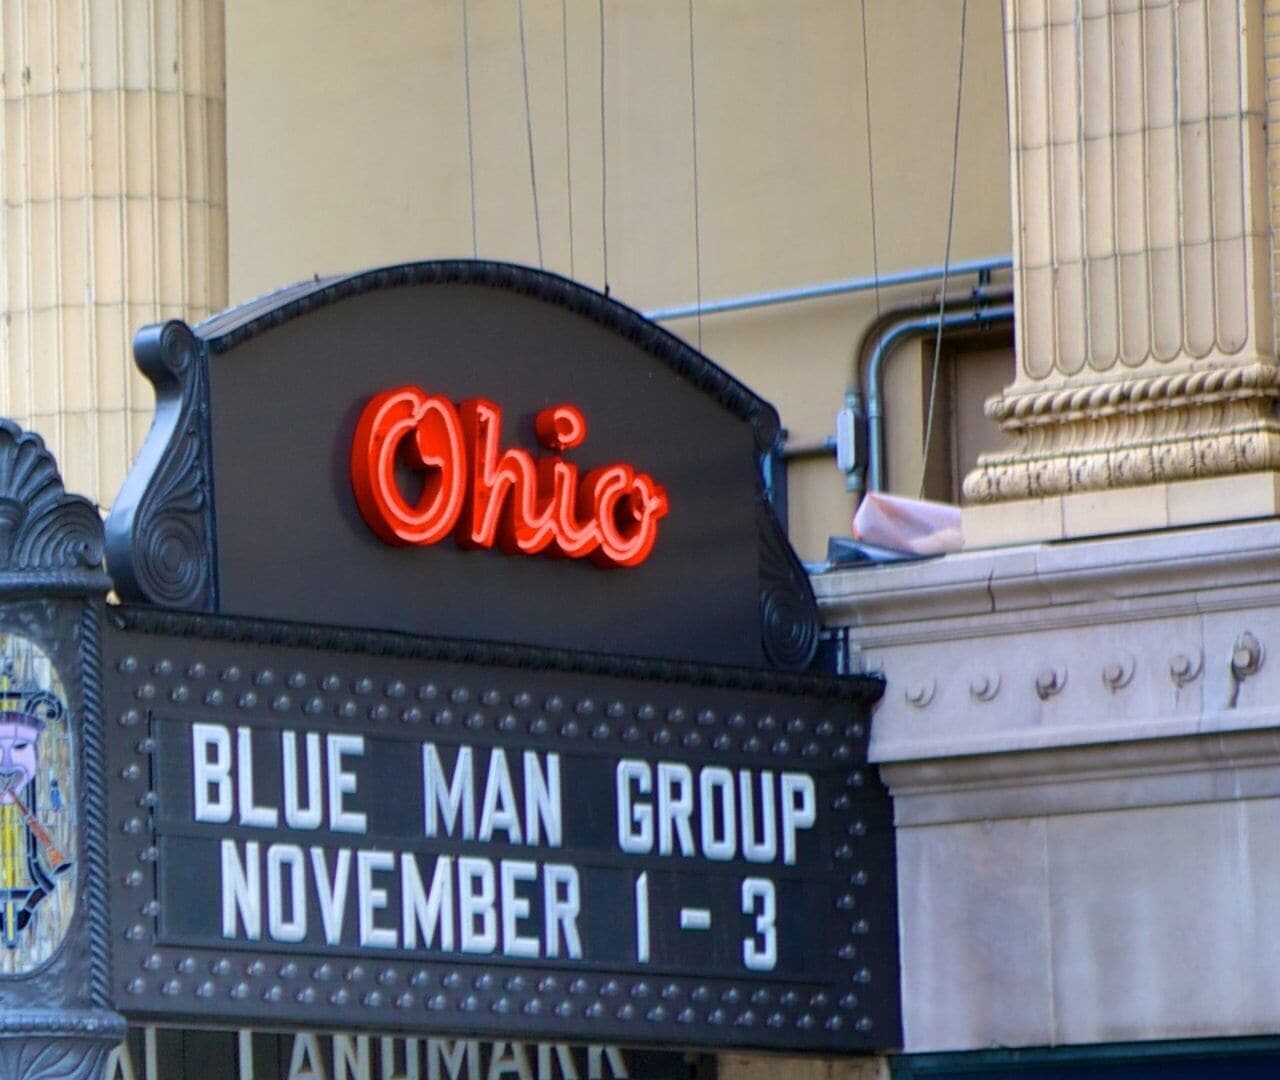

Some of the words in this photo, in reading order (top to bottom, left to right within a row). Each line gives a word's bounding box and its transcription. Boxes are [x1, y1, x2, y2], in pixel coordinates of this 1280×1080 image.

[351, 385, 670, 569] Ohio
[191, 722, 368, 834] BLUE
[422, 743, 563, 847] MAN
[616, 758, 817, 865] GROUP
[221, 839, 583, 960] NOVEMBER
